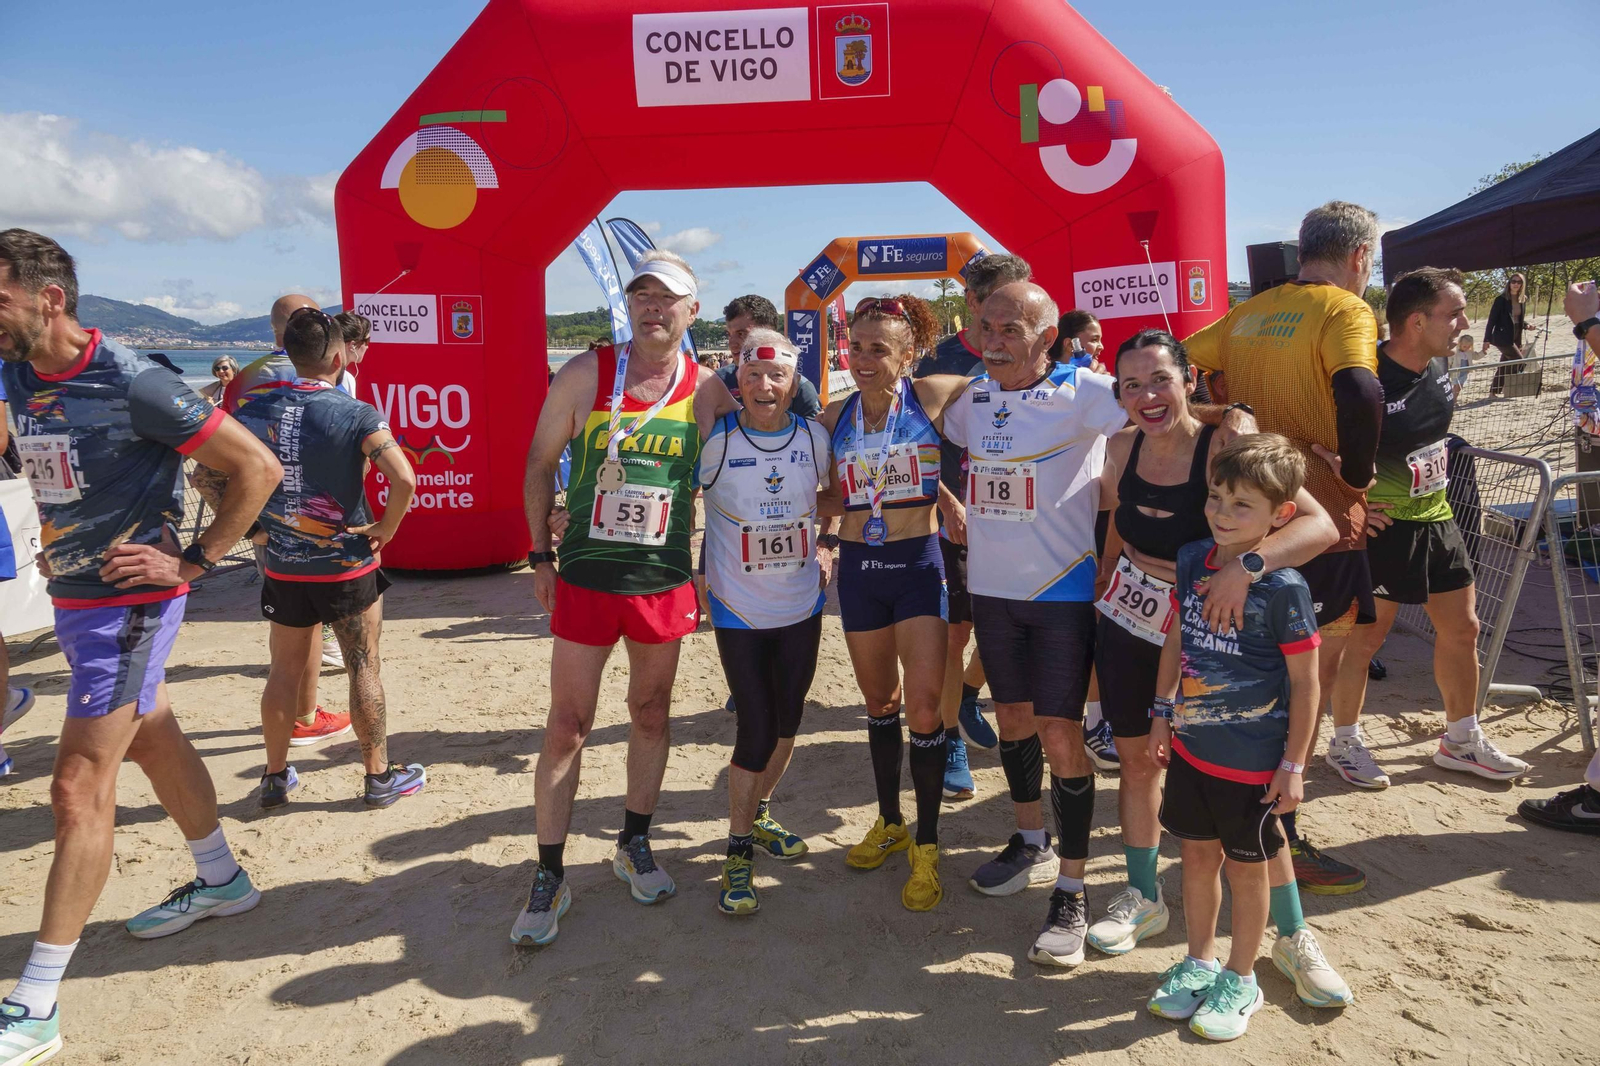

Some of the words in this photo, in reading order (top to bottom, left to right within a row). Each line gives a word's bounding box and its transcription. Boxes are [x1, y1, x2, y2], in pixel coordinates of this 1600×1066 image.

[646, 26, 795, 54] CONCELLO
[665, 60, 701, 84] DE
[710, 57, 778, 82] VIGO
[881, 245, 904, 263] FE
[905, 251, 944, 264] seguros
[1081, 273, 1169, 294] CONCELLO
[1092, 296, 1114, 309] DE
[1119, 290, 1160, 306] VIGO
[358, 304, 429, 317] CONCELLO
[384, 320, 419, 332] VIGO
[371, 383, 471, 429] VIGO
[1034, 390, 1050, 401] FE
[294, 405, 305, 427] SAMIL
[280, 406, 297, 462] CARREIRA
[292, 426, 300, 437] DE
[291, 438, 300, 462] PRAIA
[595, 430, 684, 457] BKILA
[981, 440, 1012, 450] SAMIL
[1424, 456, 1446, 479] 310
[282, 465, 296, 492] 100
[377, 485, 474, 513] dporte
[987, 480, 1011, 501] 18
[616, 502, 646, 524] 53
[760, 506, 791, 515] SAMIL
[758, 535, 793, 555] 161
[870, 560, 884, 569] FE
[1118, 583, 1158, 618] 290
